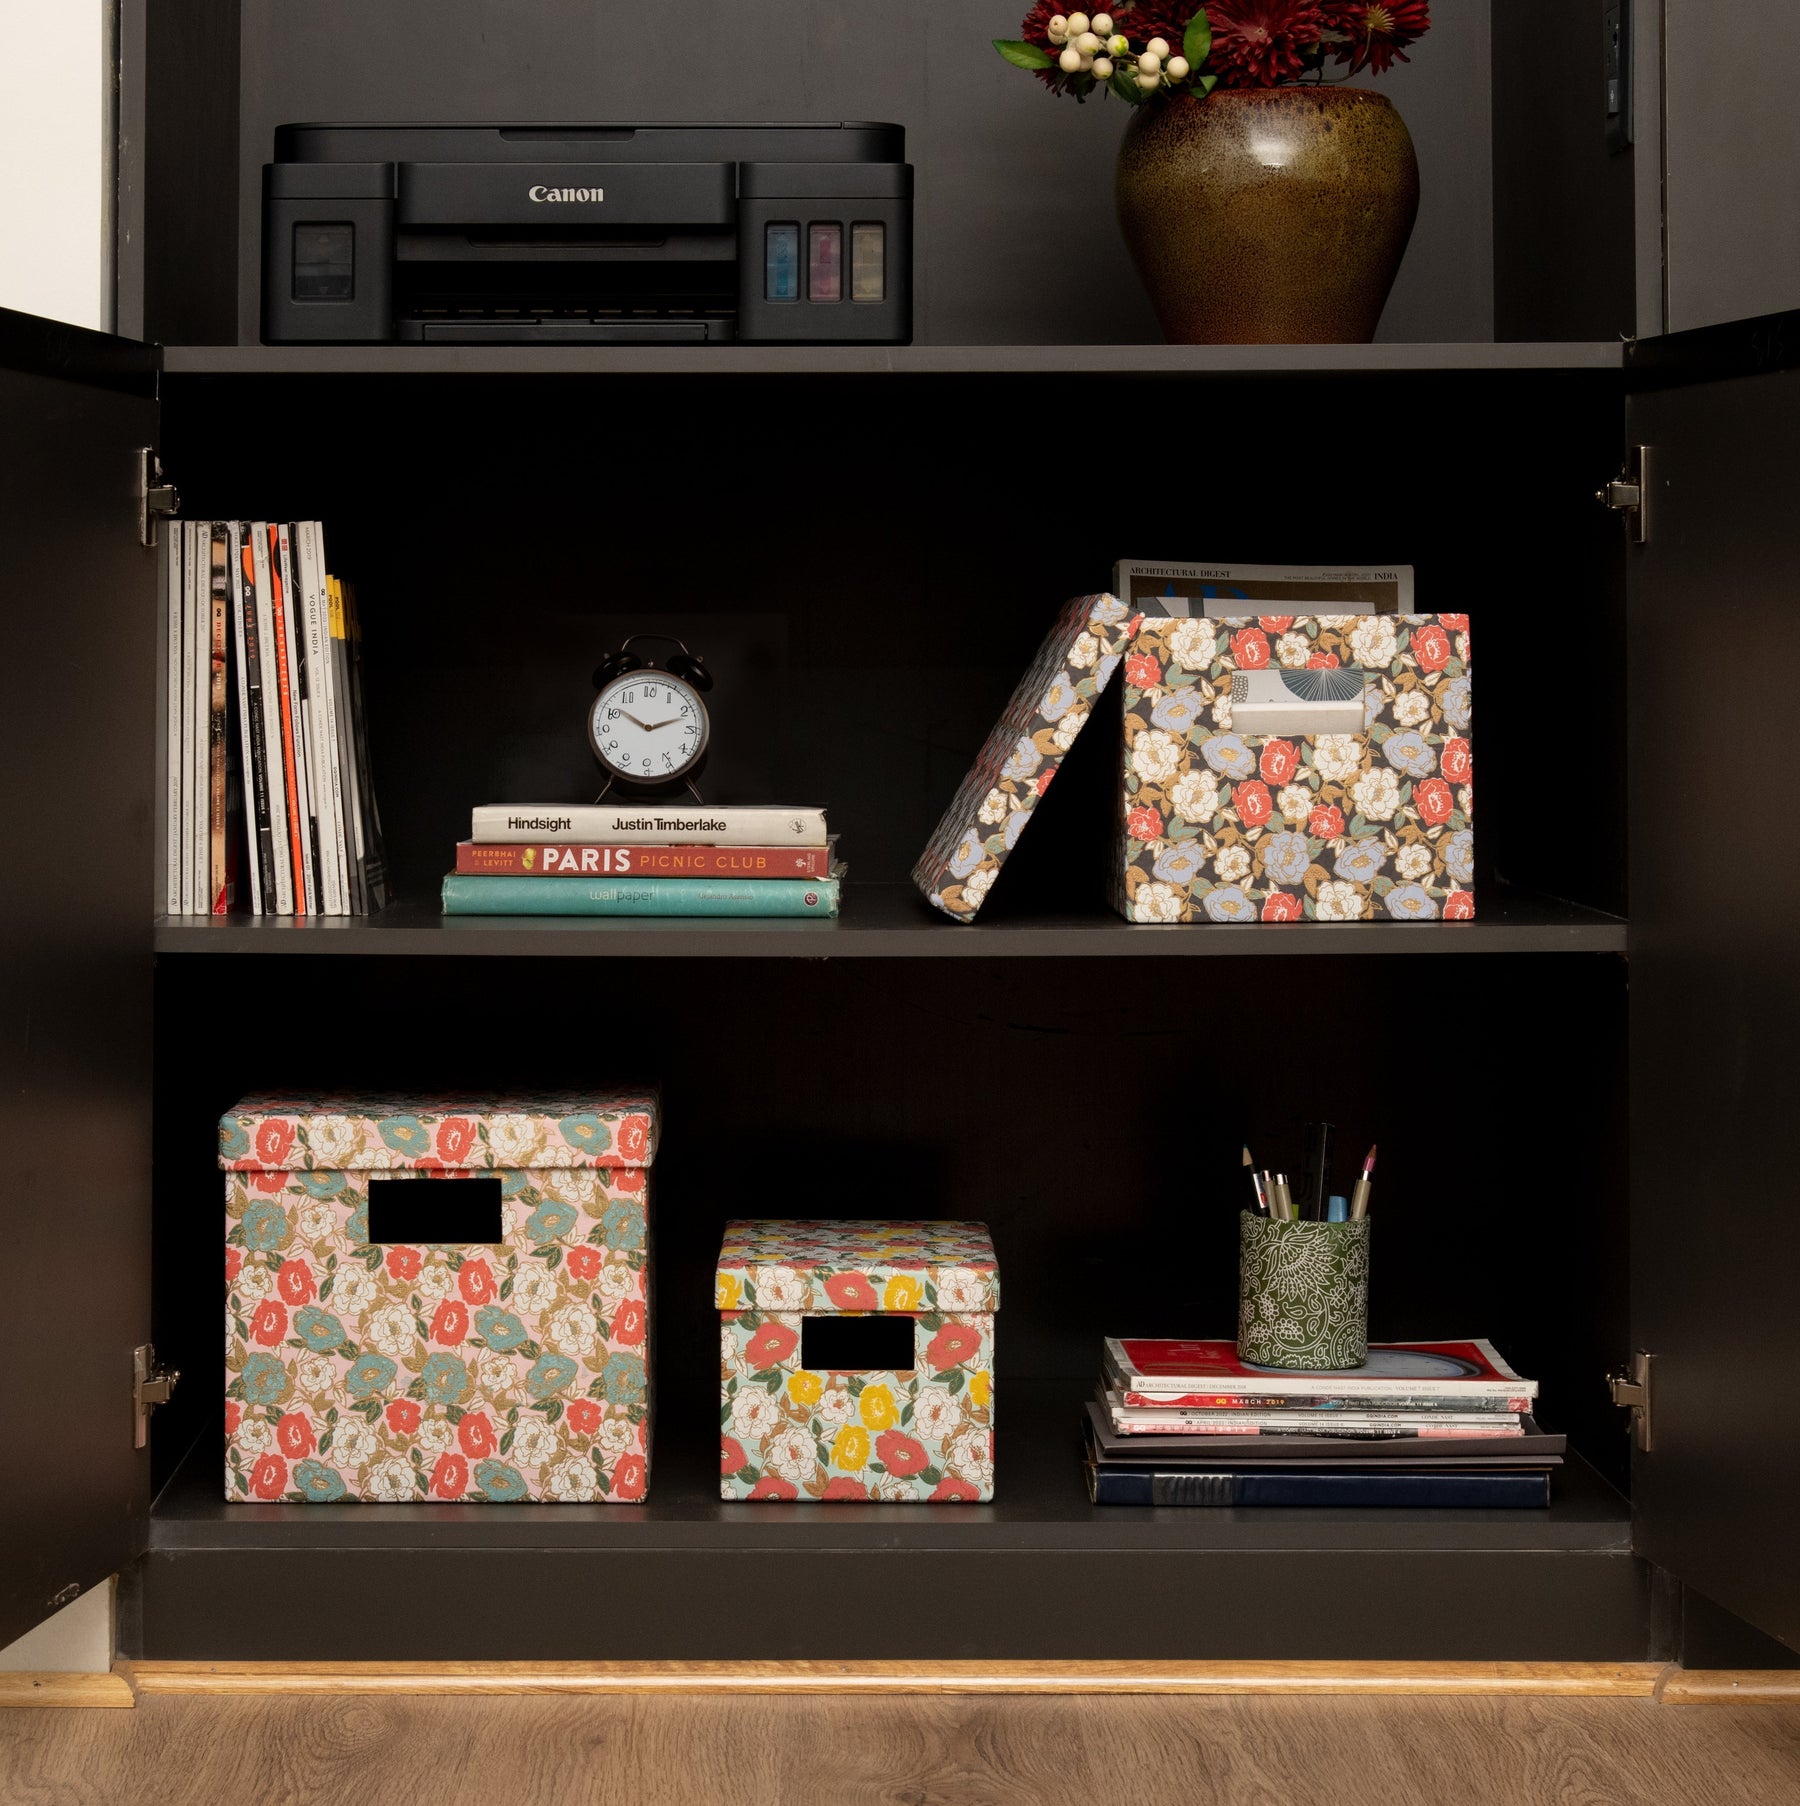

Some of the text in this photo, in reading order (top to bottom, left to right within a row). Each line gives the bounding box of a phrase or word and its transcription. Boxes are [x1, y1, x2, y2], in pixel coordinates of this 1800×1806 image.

[528, 185, 604, 202] Canon
[1130, 567, 1231, 578] ARCHITECTURAL DIGEST
[246, 586, 251, 596] GQ
[321, 588, 326, 596] GQ
[216, 608, 222, 617] GQ
[680, 706, 689, 717] 2
[508, 817, 571, 832] Hindsight
[612, 818, 727, 831] Justin Timberlake
[543, 848, 767, 872] PARIS PICNIC CLUB
[590, 889, 654, 903] wallpaper
